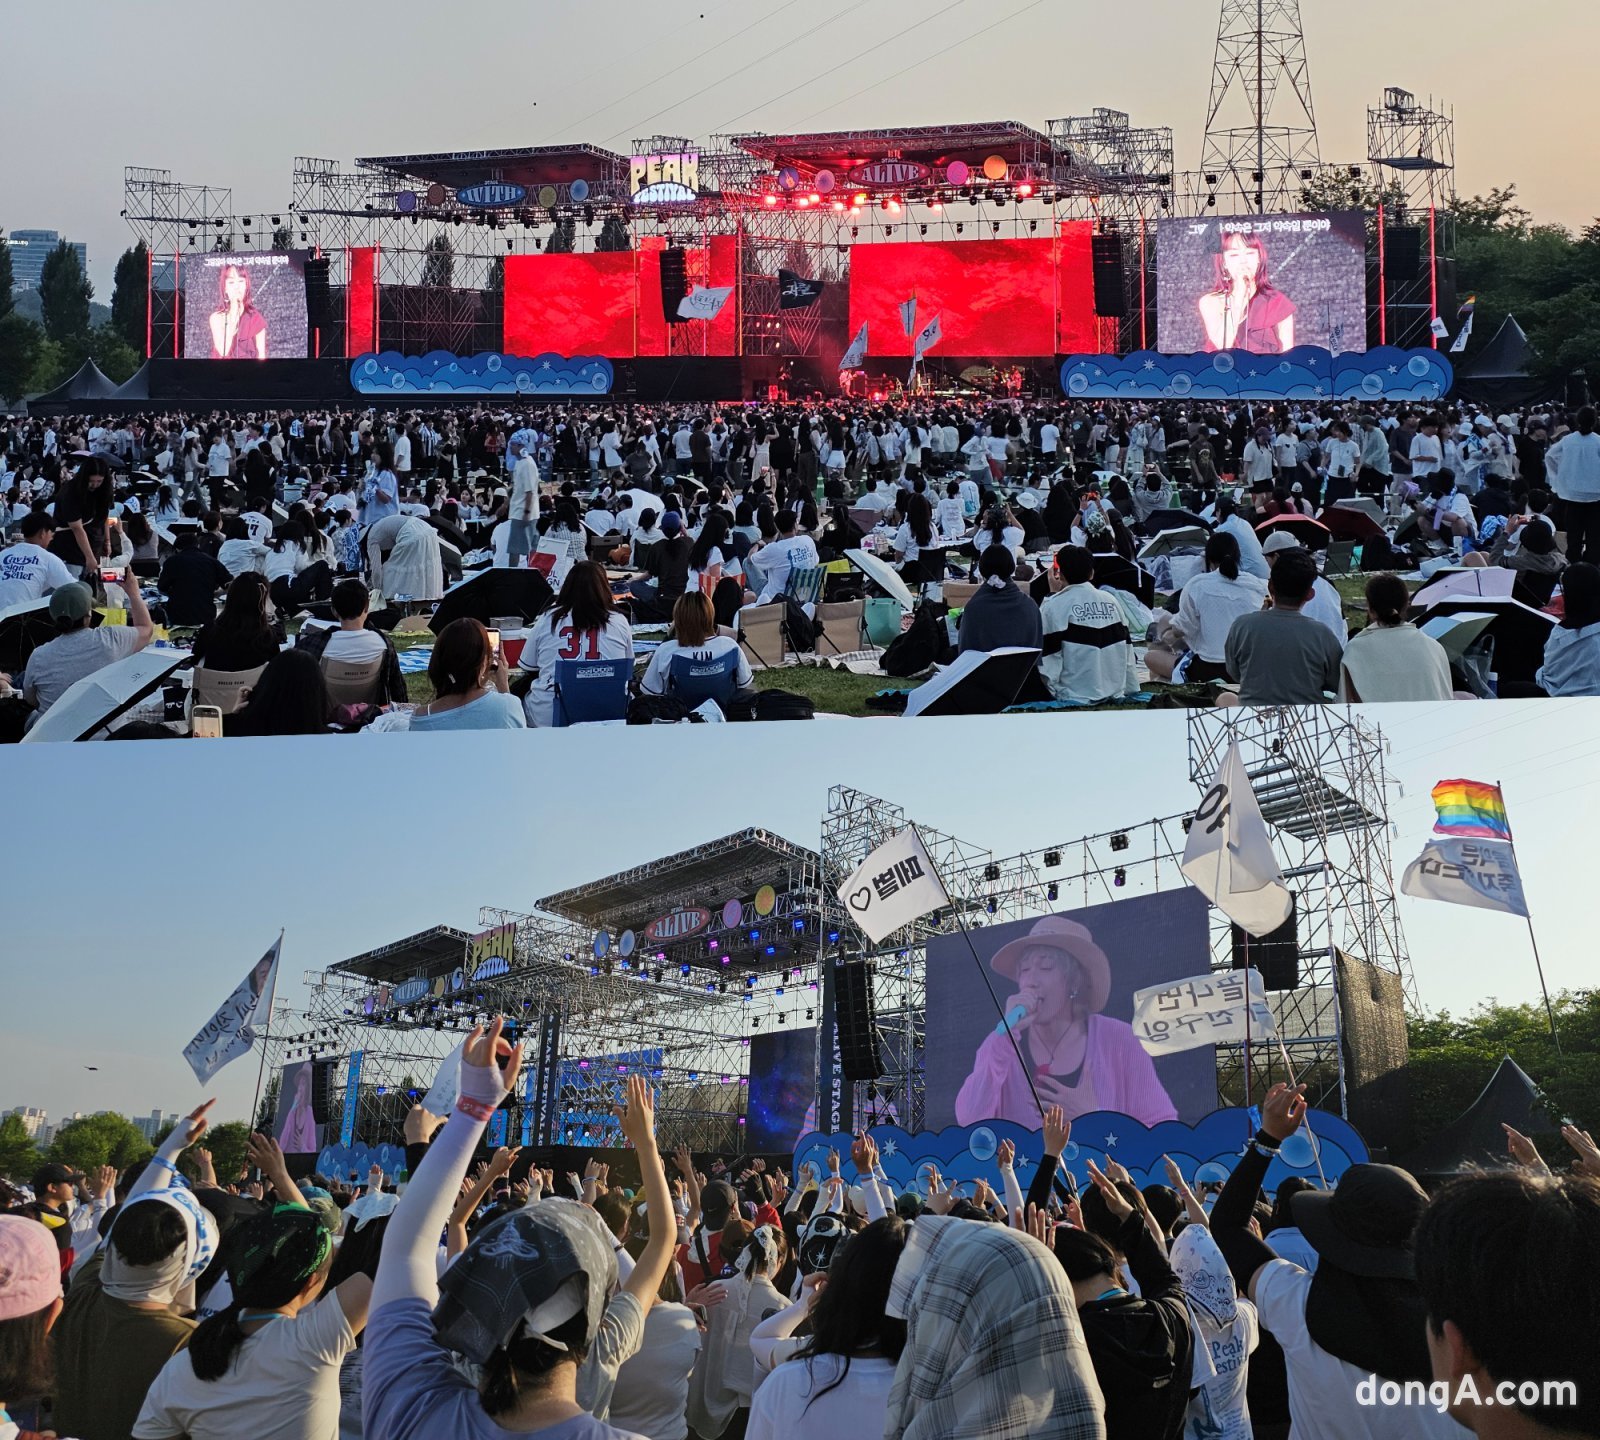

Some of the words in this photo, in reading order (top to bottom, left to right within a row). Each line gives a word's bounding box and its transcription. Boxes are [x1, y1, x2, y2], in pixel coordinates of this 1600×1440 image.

[630, 153, 699, 197] PEAK
[862, 164, 919, 183] ALIVE
[466, 185, 516, 203] WITH
[250, 524, 259, 536] 7
[1072, 601, 1115, 618] CALIF
[558, 626, 600, 661] 31
[692, 651, 713, 661] KIM
[472, 922, 516, 977] PEAK
[545, 1027, 553, 1064] PEAK
[540, 1067, 550, 1130] FESTIVAL
[831, 1078, 842, 1135] STAGE
[1212, 1335, 1243, 1359] Peak
